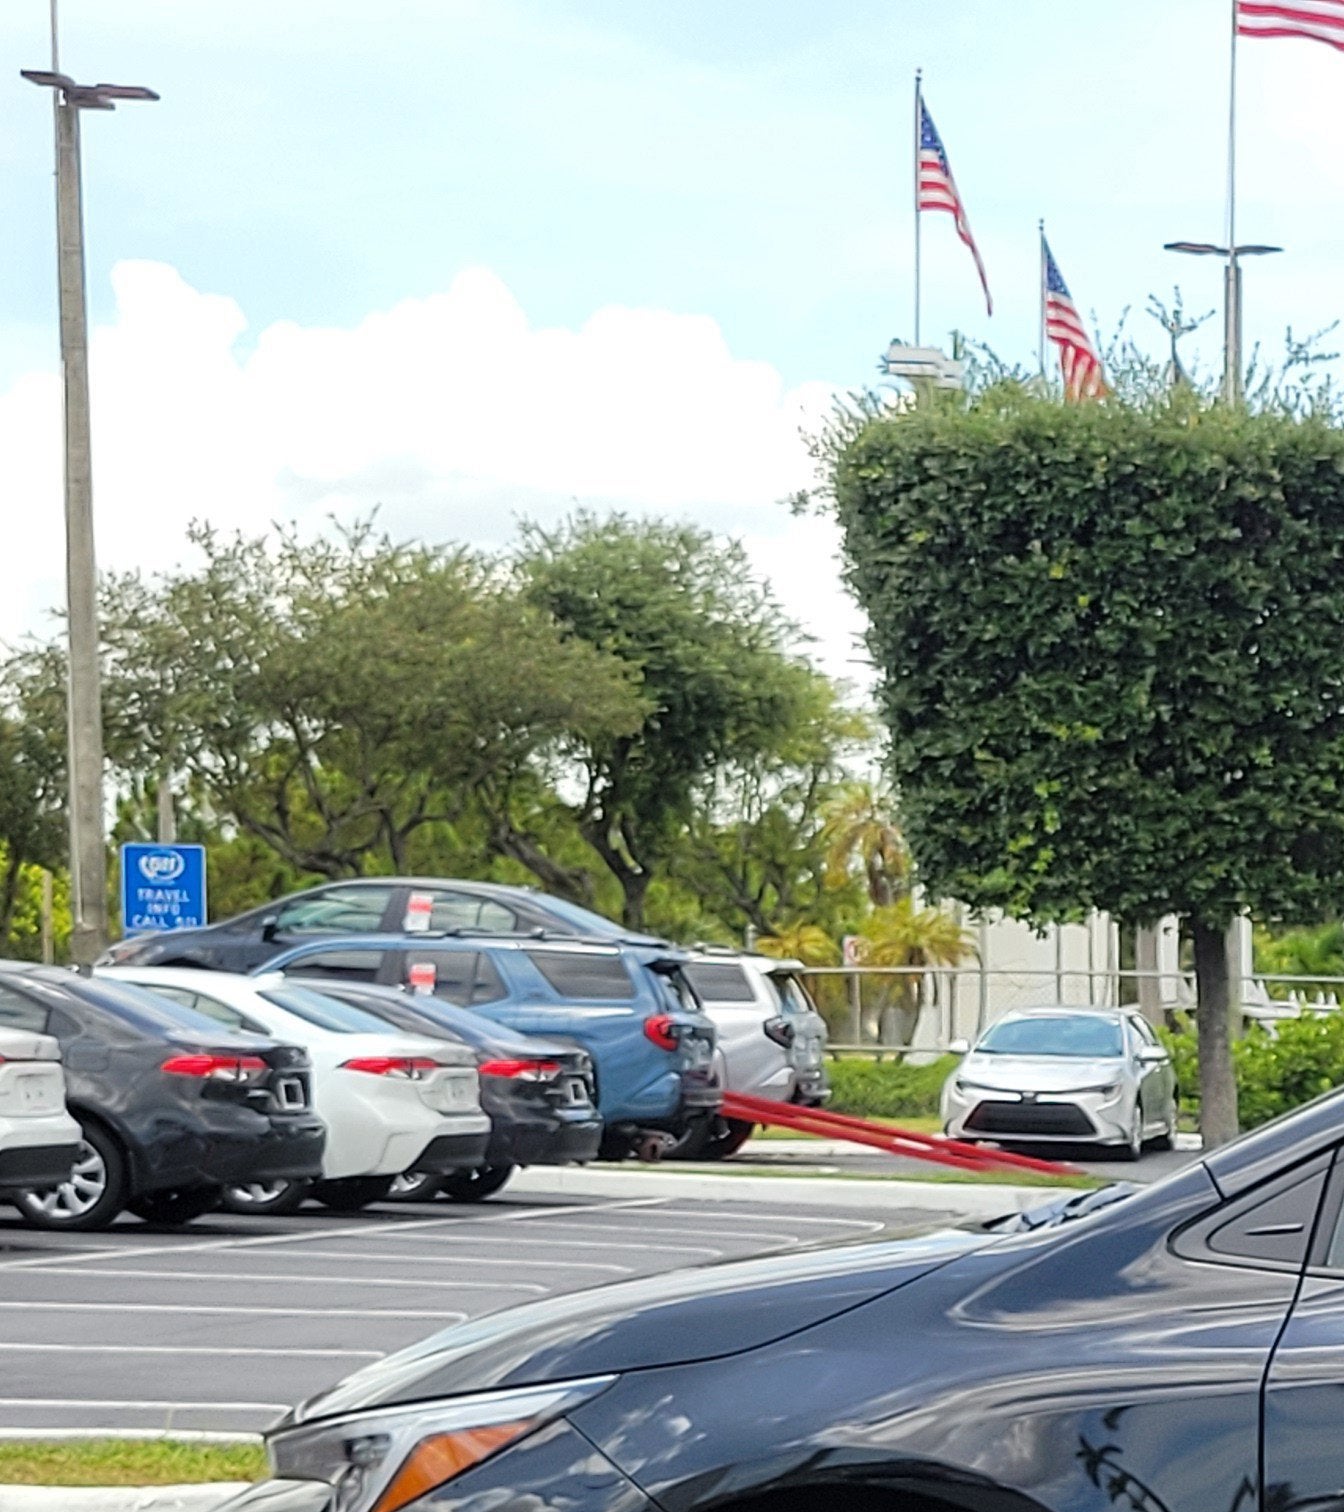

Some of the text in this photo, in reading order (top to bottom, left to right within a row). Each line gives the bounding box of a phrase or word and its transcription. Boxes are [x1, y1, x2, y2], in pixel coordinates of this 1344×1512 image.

[137, 888, 190, 902] TRAVEL
[147, 902, 181, 916] INFO
[132, 914, 169, 928] CALL
